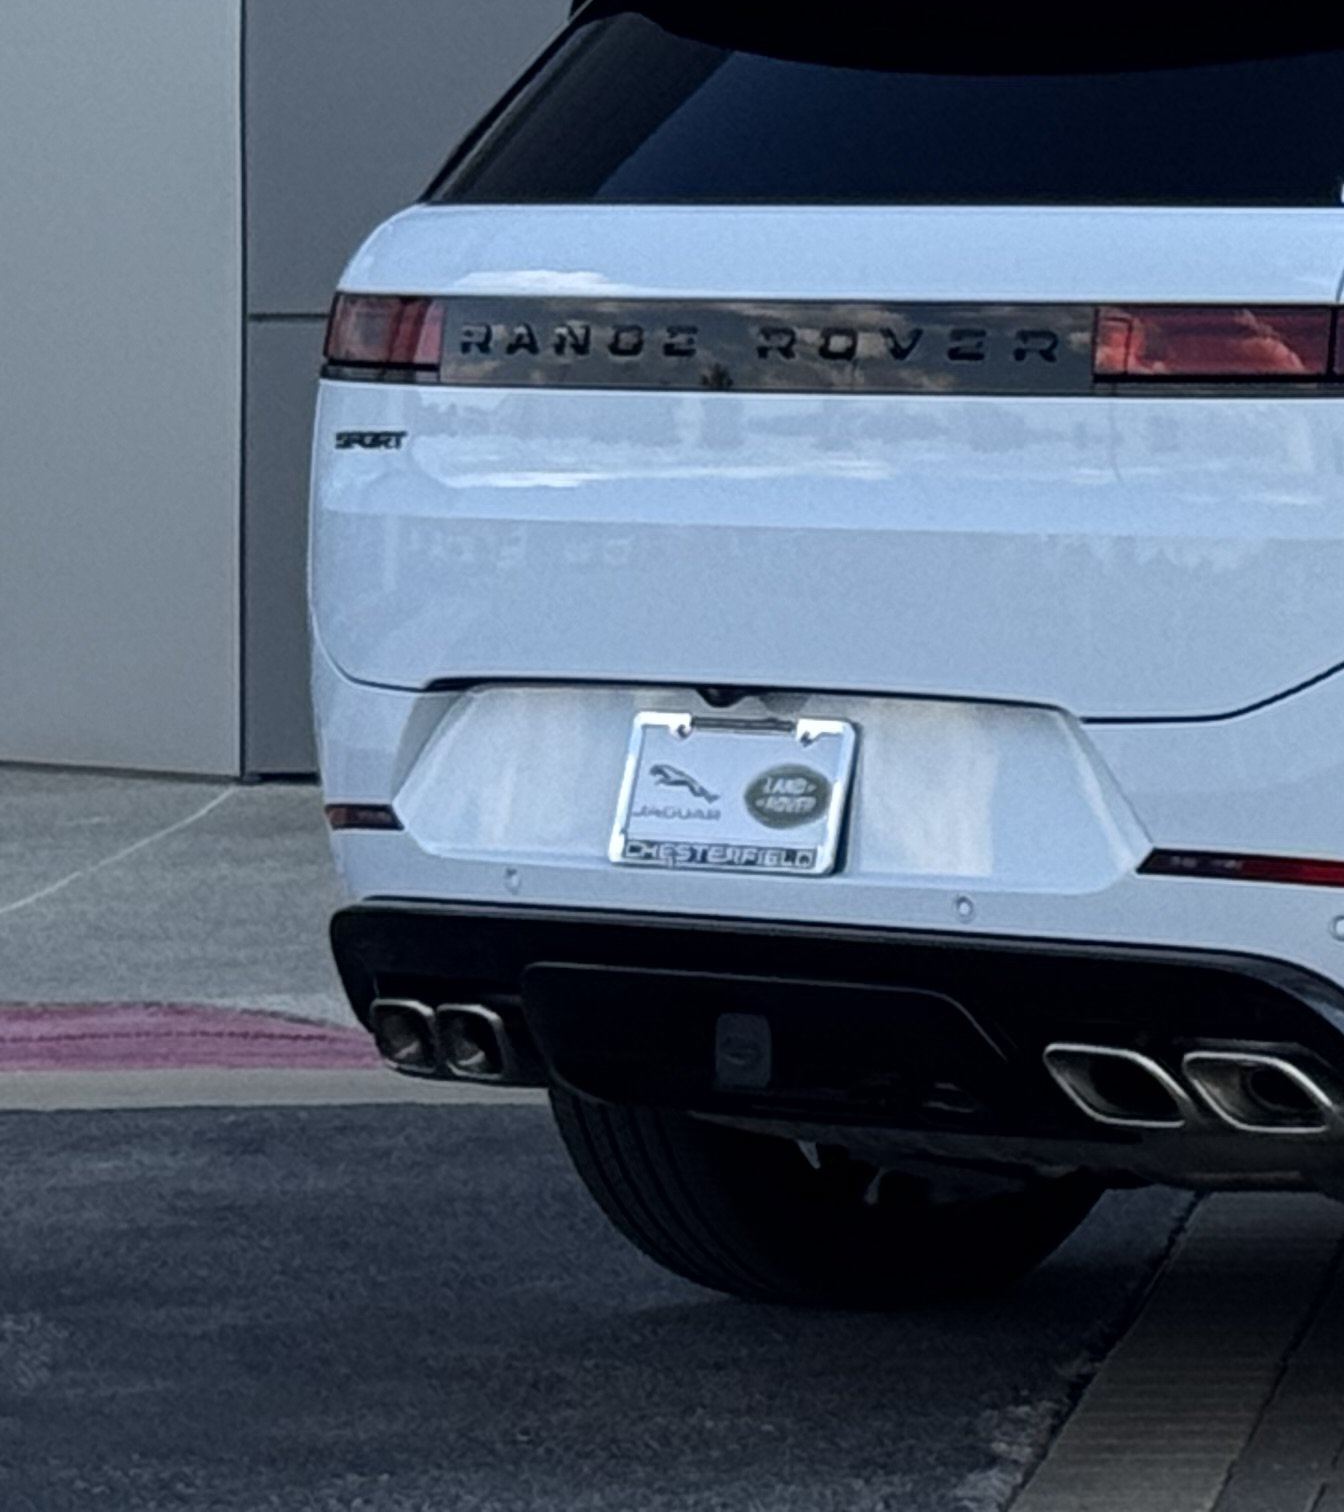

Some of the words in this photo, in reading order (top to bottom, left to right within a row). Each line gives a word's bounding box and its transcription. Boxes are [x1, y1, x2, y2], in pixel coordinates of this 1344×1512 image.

[460, 323, 699, 357] RANGE
[756, 327, 1059, 363] ROVER
[335, 431, 408, 450] SPORT
[632, 804, 721, 821] JAGUAR
[624, 841, 816, 870] CHESTERFIELD
